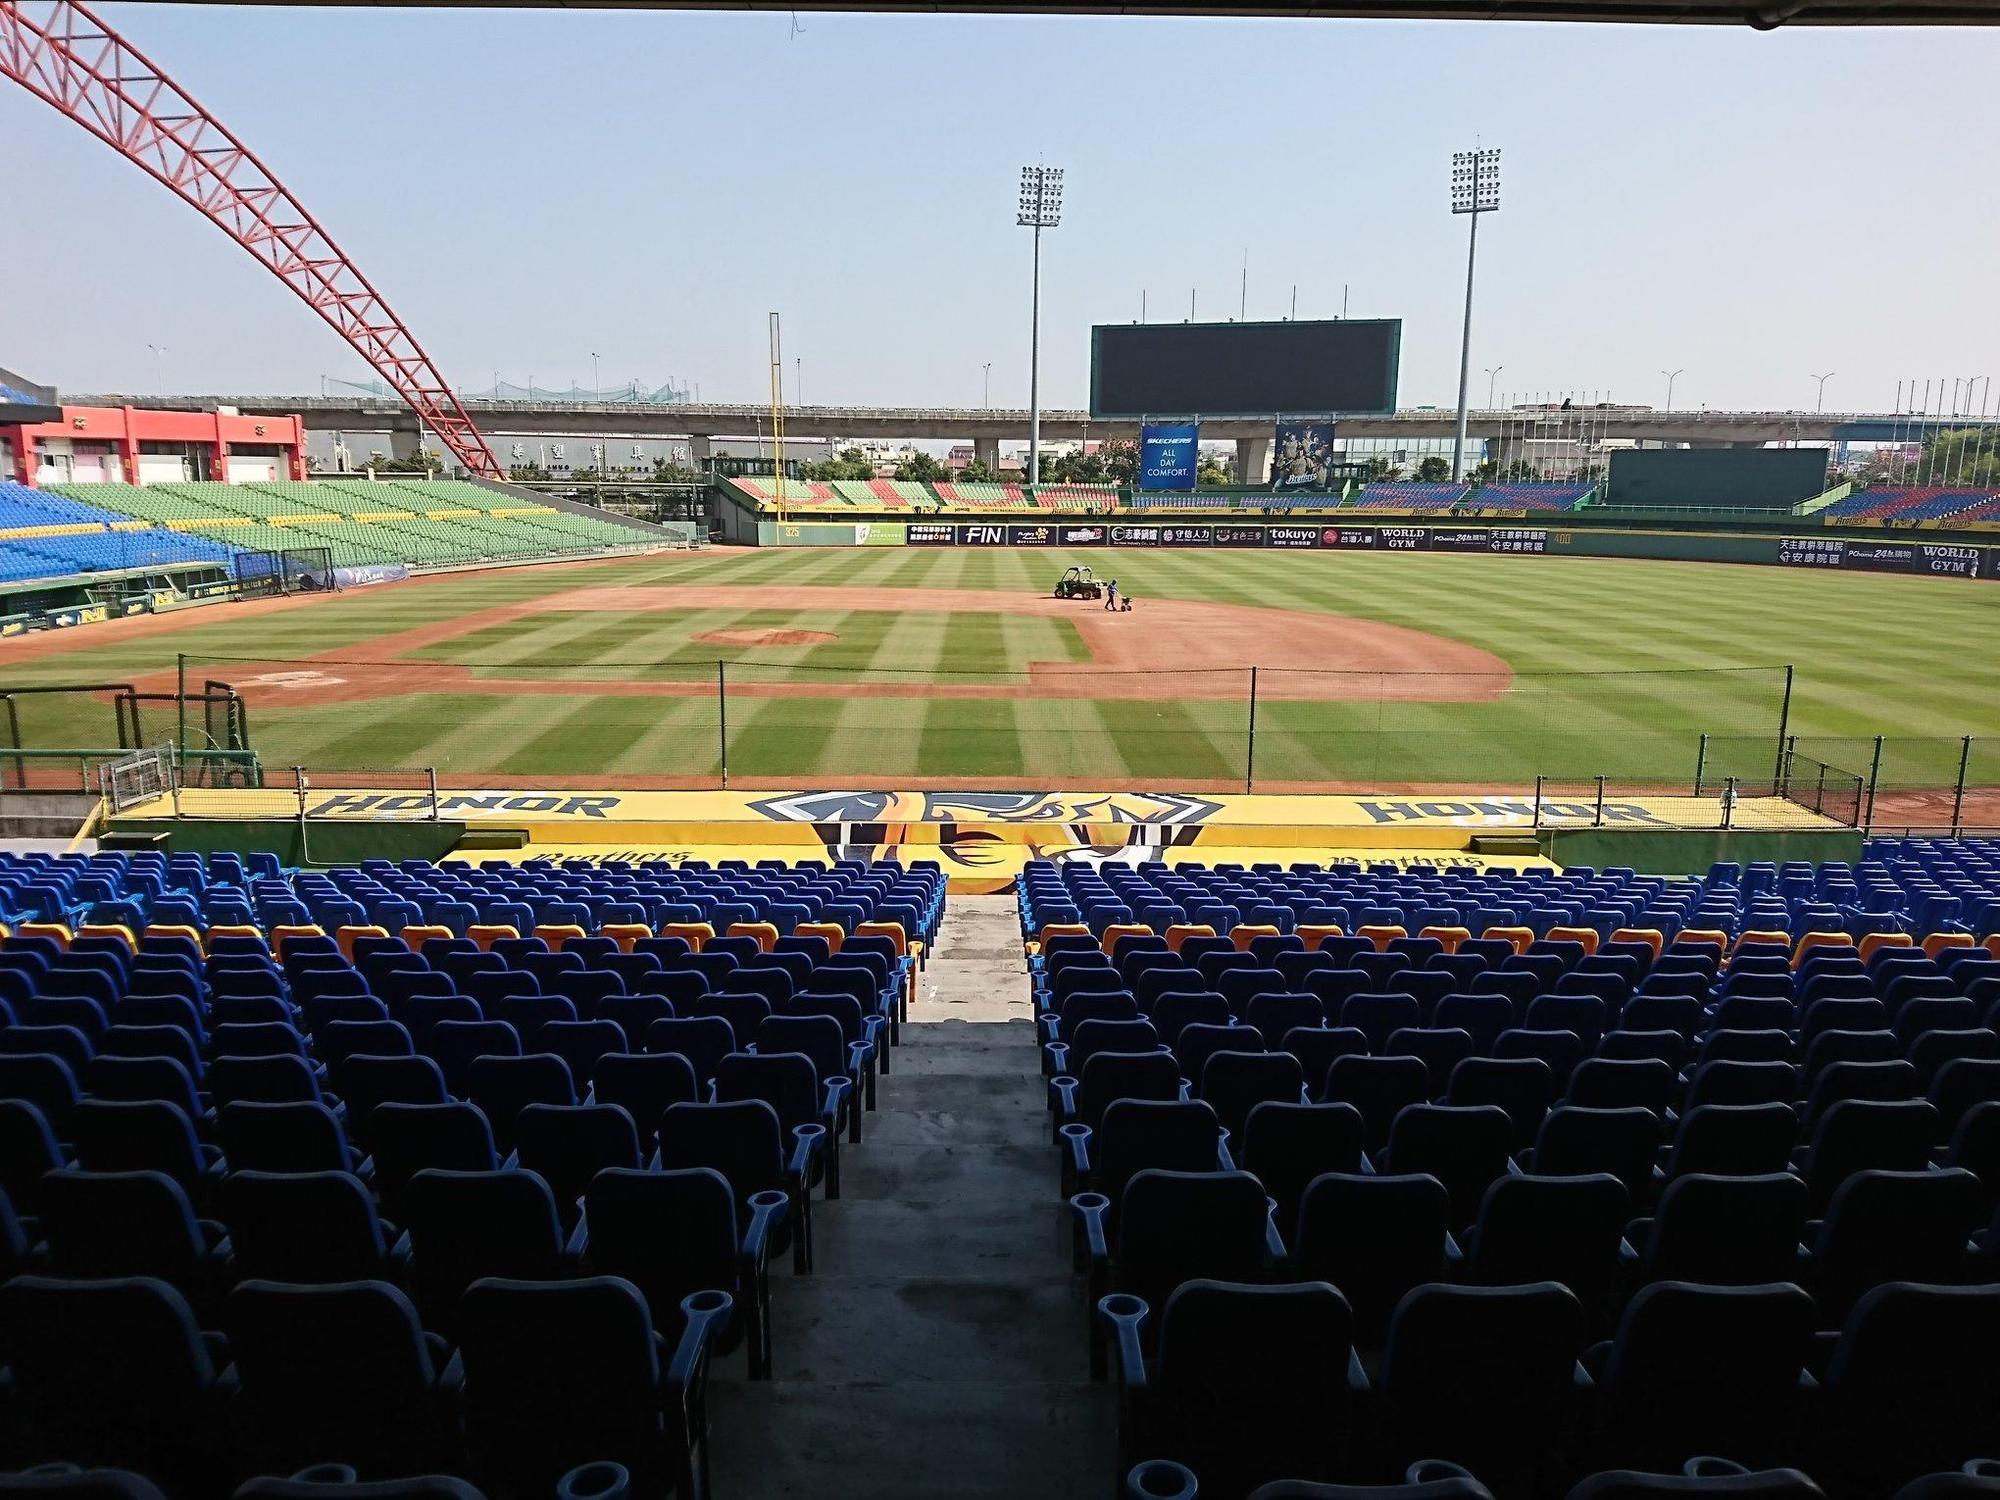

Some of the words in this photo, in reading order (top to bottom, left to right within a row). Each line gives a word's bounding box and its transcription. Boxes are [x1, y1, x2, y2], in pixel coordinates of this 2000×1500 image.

[1160, 459, 1176, 467] DAY
[1147, 468, 1189, 477] COMFORT.
[966, 527, 1002, 543] FIN
[1271, 528, 1316, 540] tokuyo
[1381, 529, 1425, 537] WORLD
[1388, 540, 1416, 548] GYM
[1792, 553, 1840, 564] 安康院區
[1923, 546, 1979, 559] WORLD
[1931, 560, 1966, 572] GYM
[306, 795, 621, 818] HONOR
[1356, 802, 1675, 824] HONOR
